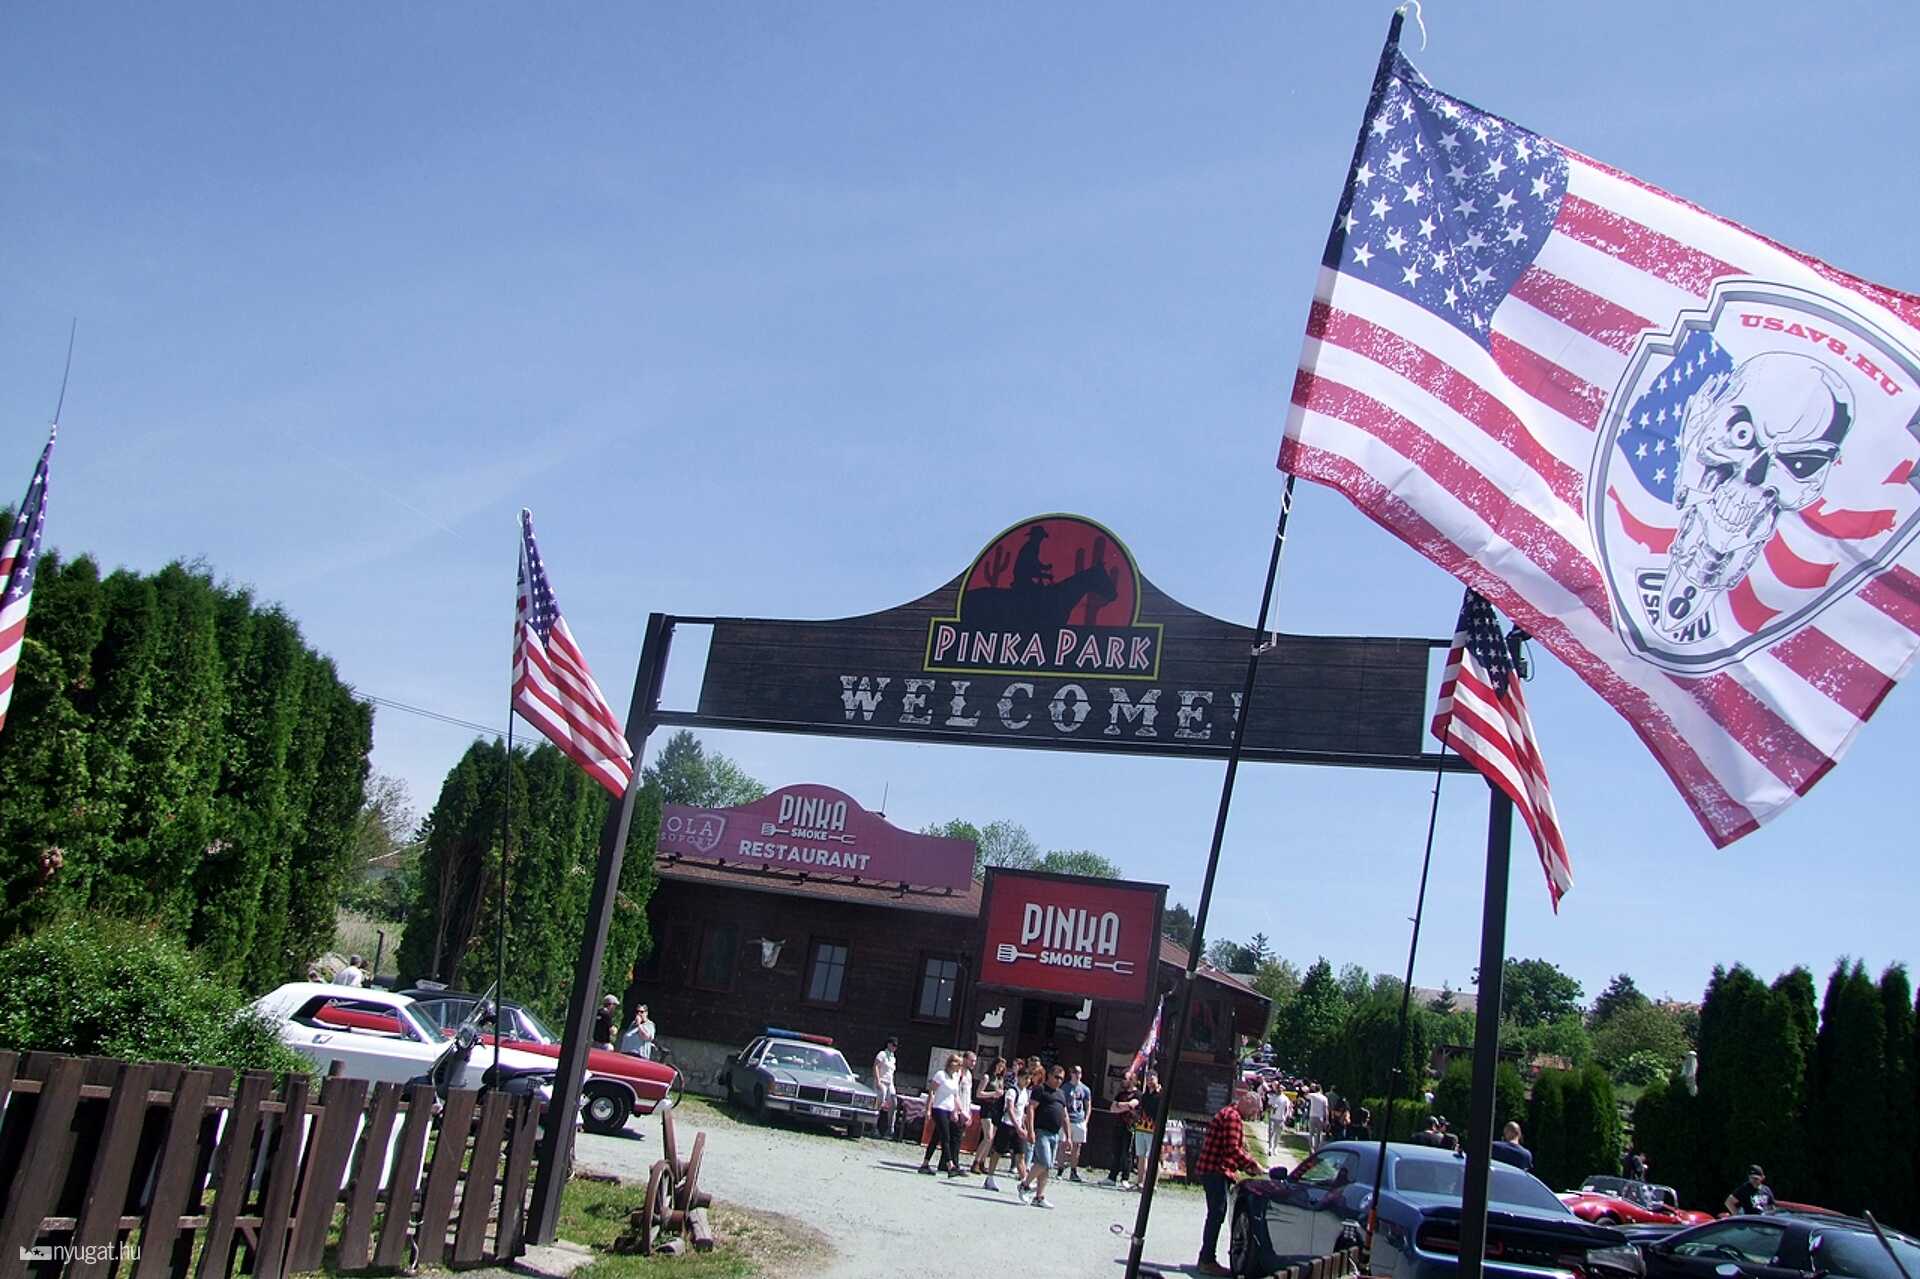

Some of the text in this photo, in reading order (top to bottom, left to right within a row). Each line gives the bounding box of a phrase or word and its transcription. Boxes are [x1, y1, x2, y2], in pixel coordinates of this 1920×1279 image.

[1740, 314, 1903, 396] USAV8.HU
[934, 625, 1151, 670] PINKA PARK
[778, 794, 847, 832] PINKA
[791, 828, 828, 841] SMOKE
[739, 840, 871, 870] RESTAURANT
[1021, 903, 1120, 956] PINKA
[1039, 951, 1093, 969] SMOKE
